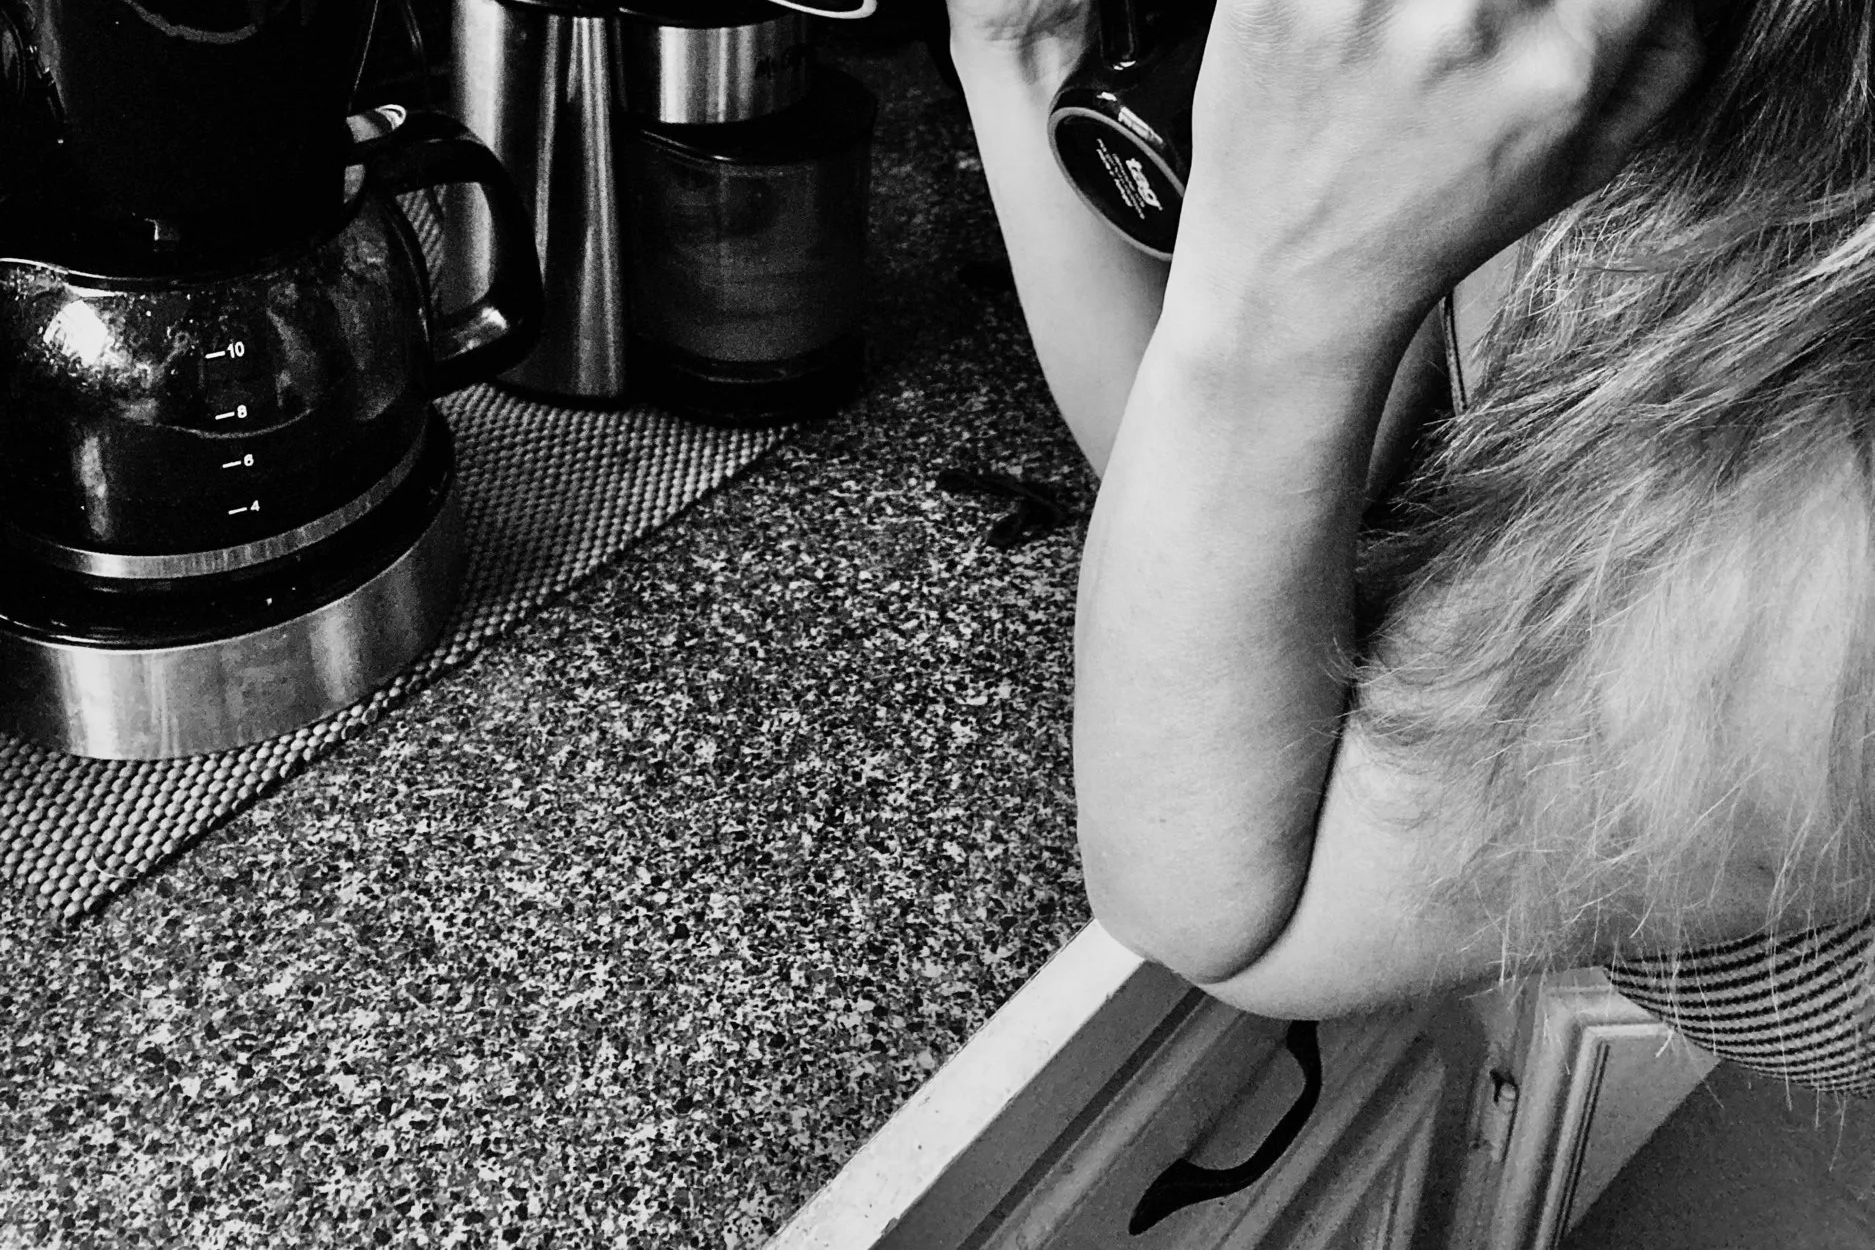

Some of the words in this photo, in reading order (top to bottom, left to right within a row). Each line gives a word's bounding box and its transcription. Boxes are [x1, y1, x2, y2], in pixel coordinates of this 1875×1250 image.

[226, 341, 245, 359] 10
[237, 404, 248, 419] 8
[243, 453, 254, 467] 6
[250, 499, 261, 512] 4
